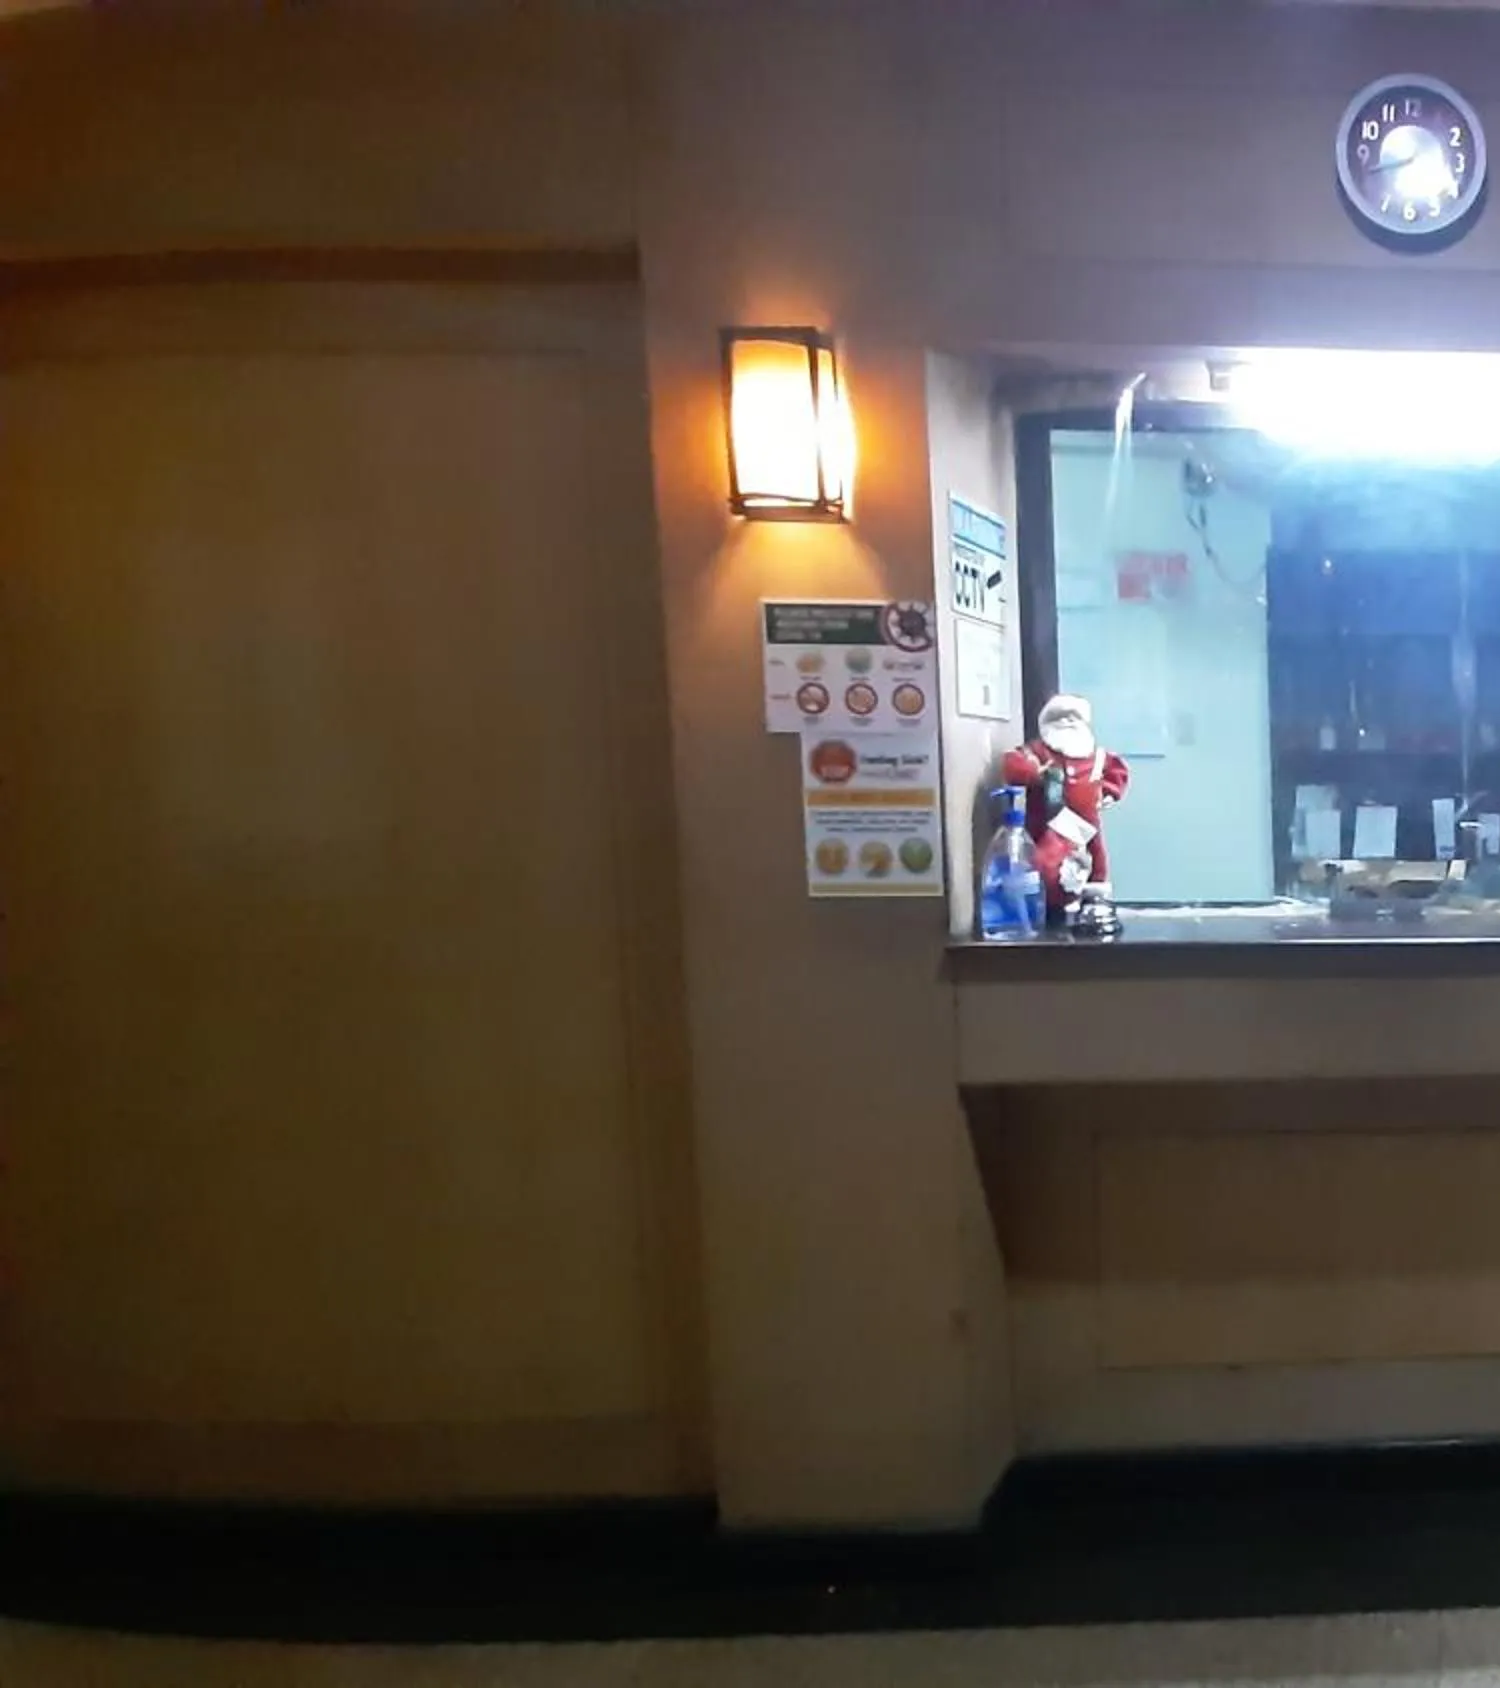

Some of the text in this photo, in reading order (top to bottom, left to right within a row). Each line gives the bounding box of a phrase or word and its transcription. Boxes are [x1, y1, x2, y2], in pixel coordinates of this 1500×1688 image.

[1382, 103, 1396, 123] 11
[1362, 120, 1380, 141] 10
[1449, 126, 1462, 147] 2
[1356, 144, 1371, 166] 9
[1455, 153, 1466, 173] 3
[1403, 200, 1417, 221] 6
